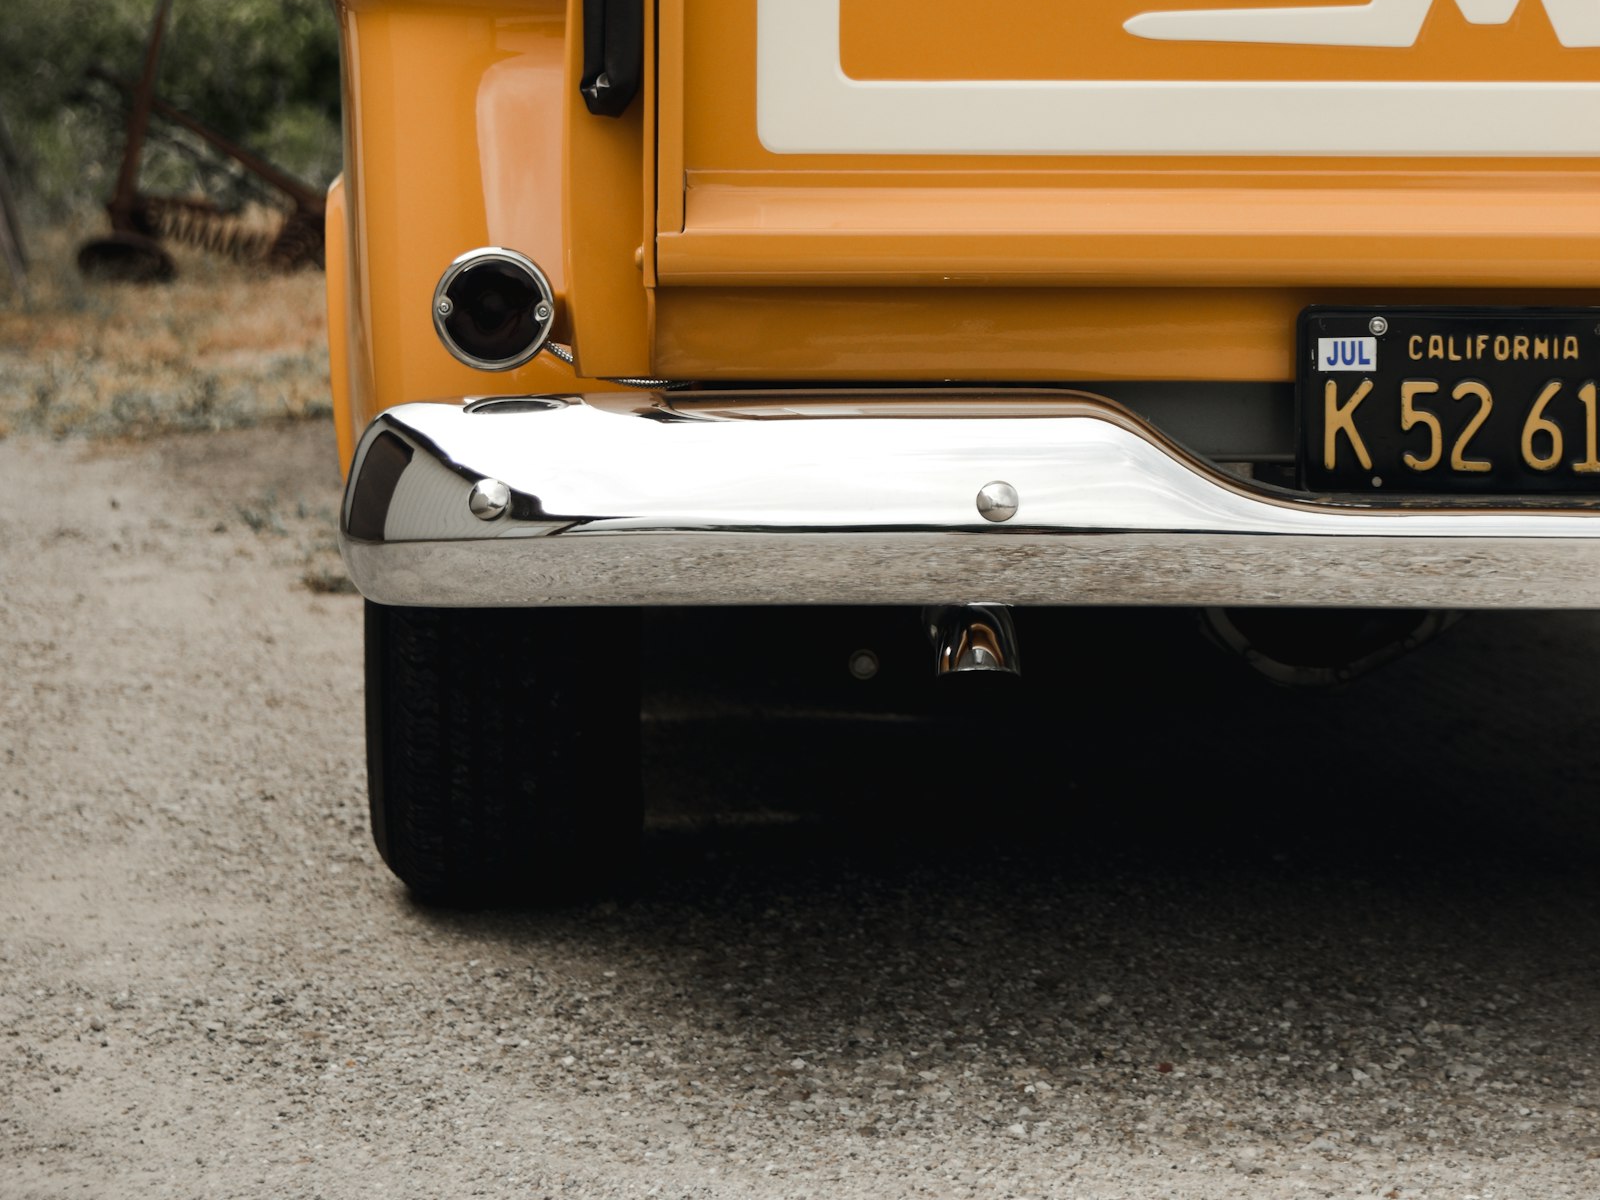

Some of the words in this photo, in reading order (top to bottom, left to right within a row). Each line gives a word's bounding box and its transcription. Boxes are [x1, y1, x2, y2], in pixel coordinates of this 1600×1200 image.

[1326, 340, 1371, 366] JUL
[1408, 335, 1579, 361] CALIFORNIA
[1324, 380, 1374, 471] K
[1401, 381, 1493, 472] 52
